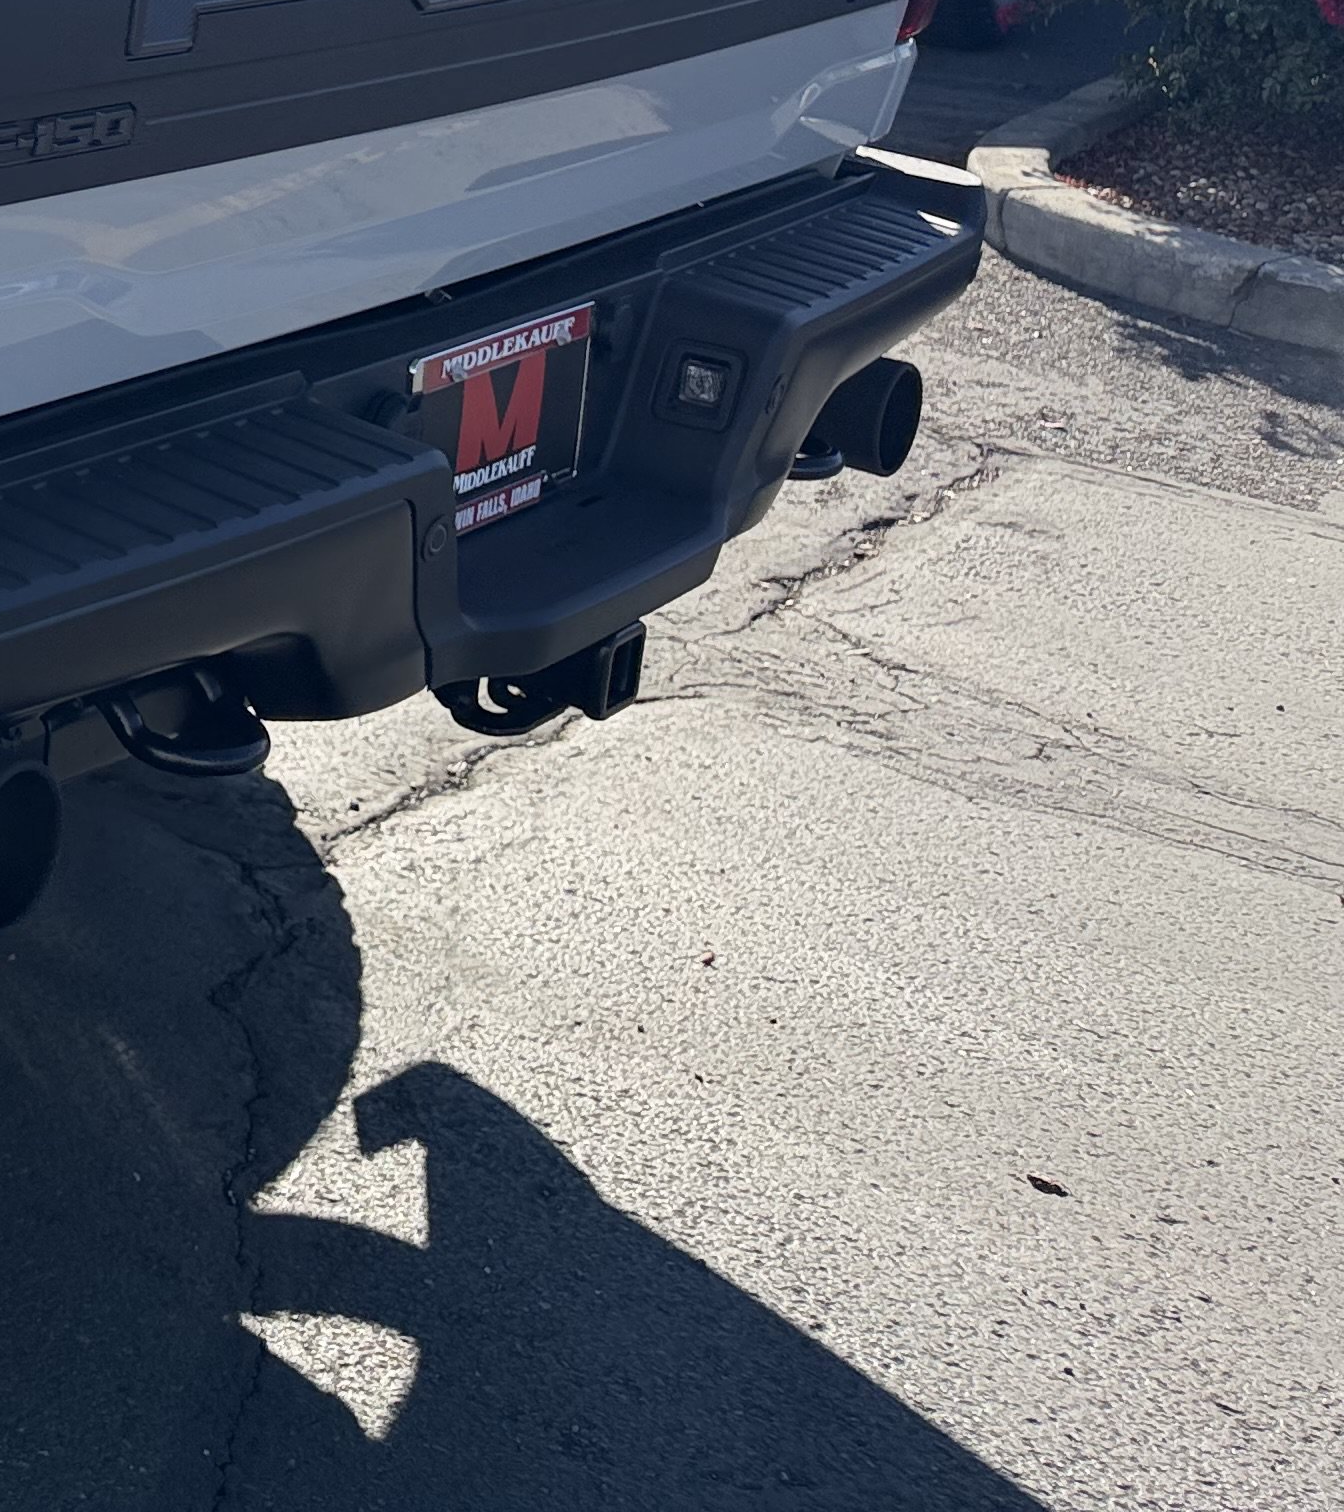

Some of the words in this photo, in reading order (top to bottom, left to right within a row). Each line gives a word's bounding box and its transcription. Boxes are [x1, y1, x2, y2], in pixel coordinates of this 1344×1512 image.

[455, 349, 547, 473] M
[453, 445, 537, 494] MIDDLEKAUFF
[510, 478, 542, 508] IDAHO
